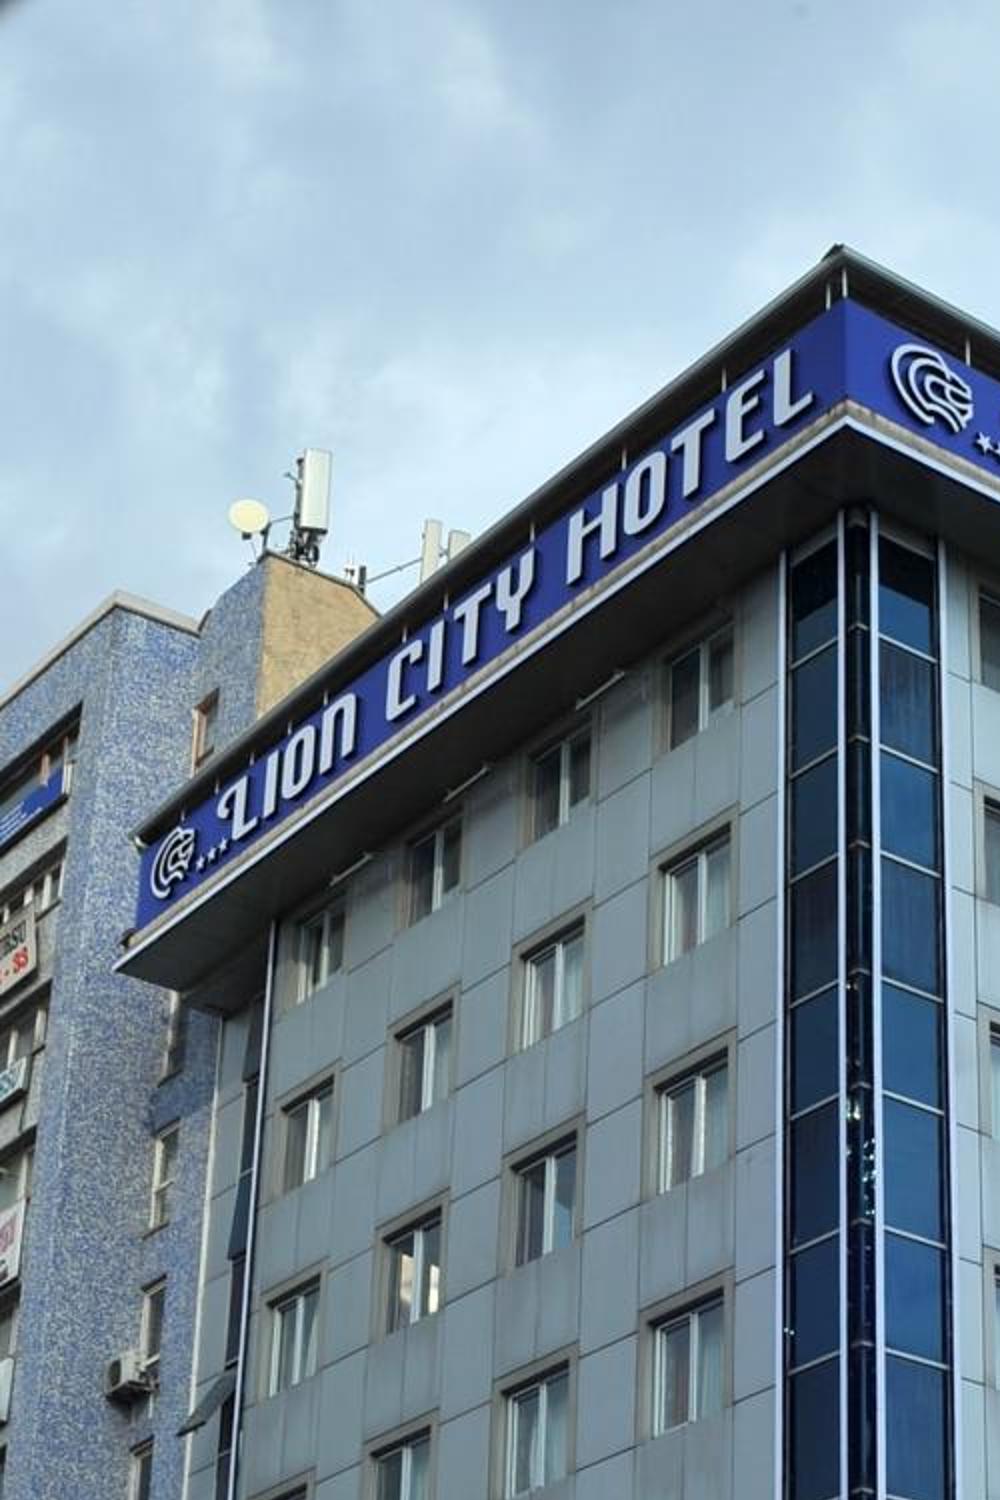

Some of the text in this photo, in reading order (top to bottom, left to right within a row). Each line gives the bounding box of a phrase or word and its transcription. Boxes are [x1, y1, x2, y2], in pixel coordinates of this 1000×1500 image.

[217, 349, 813, 840] LION CITY HOTEL
